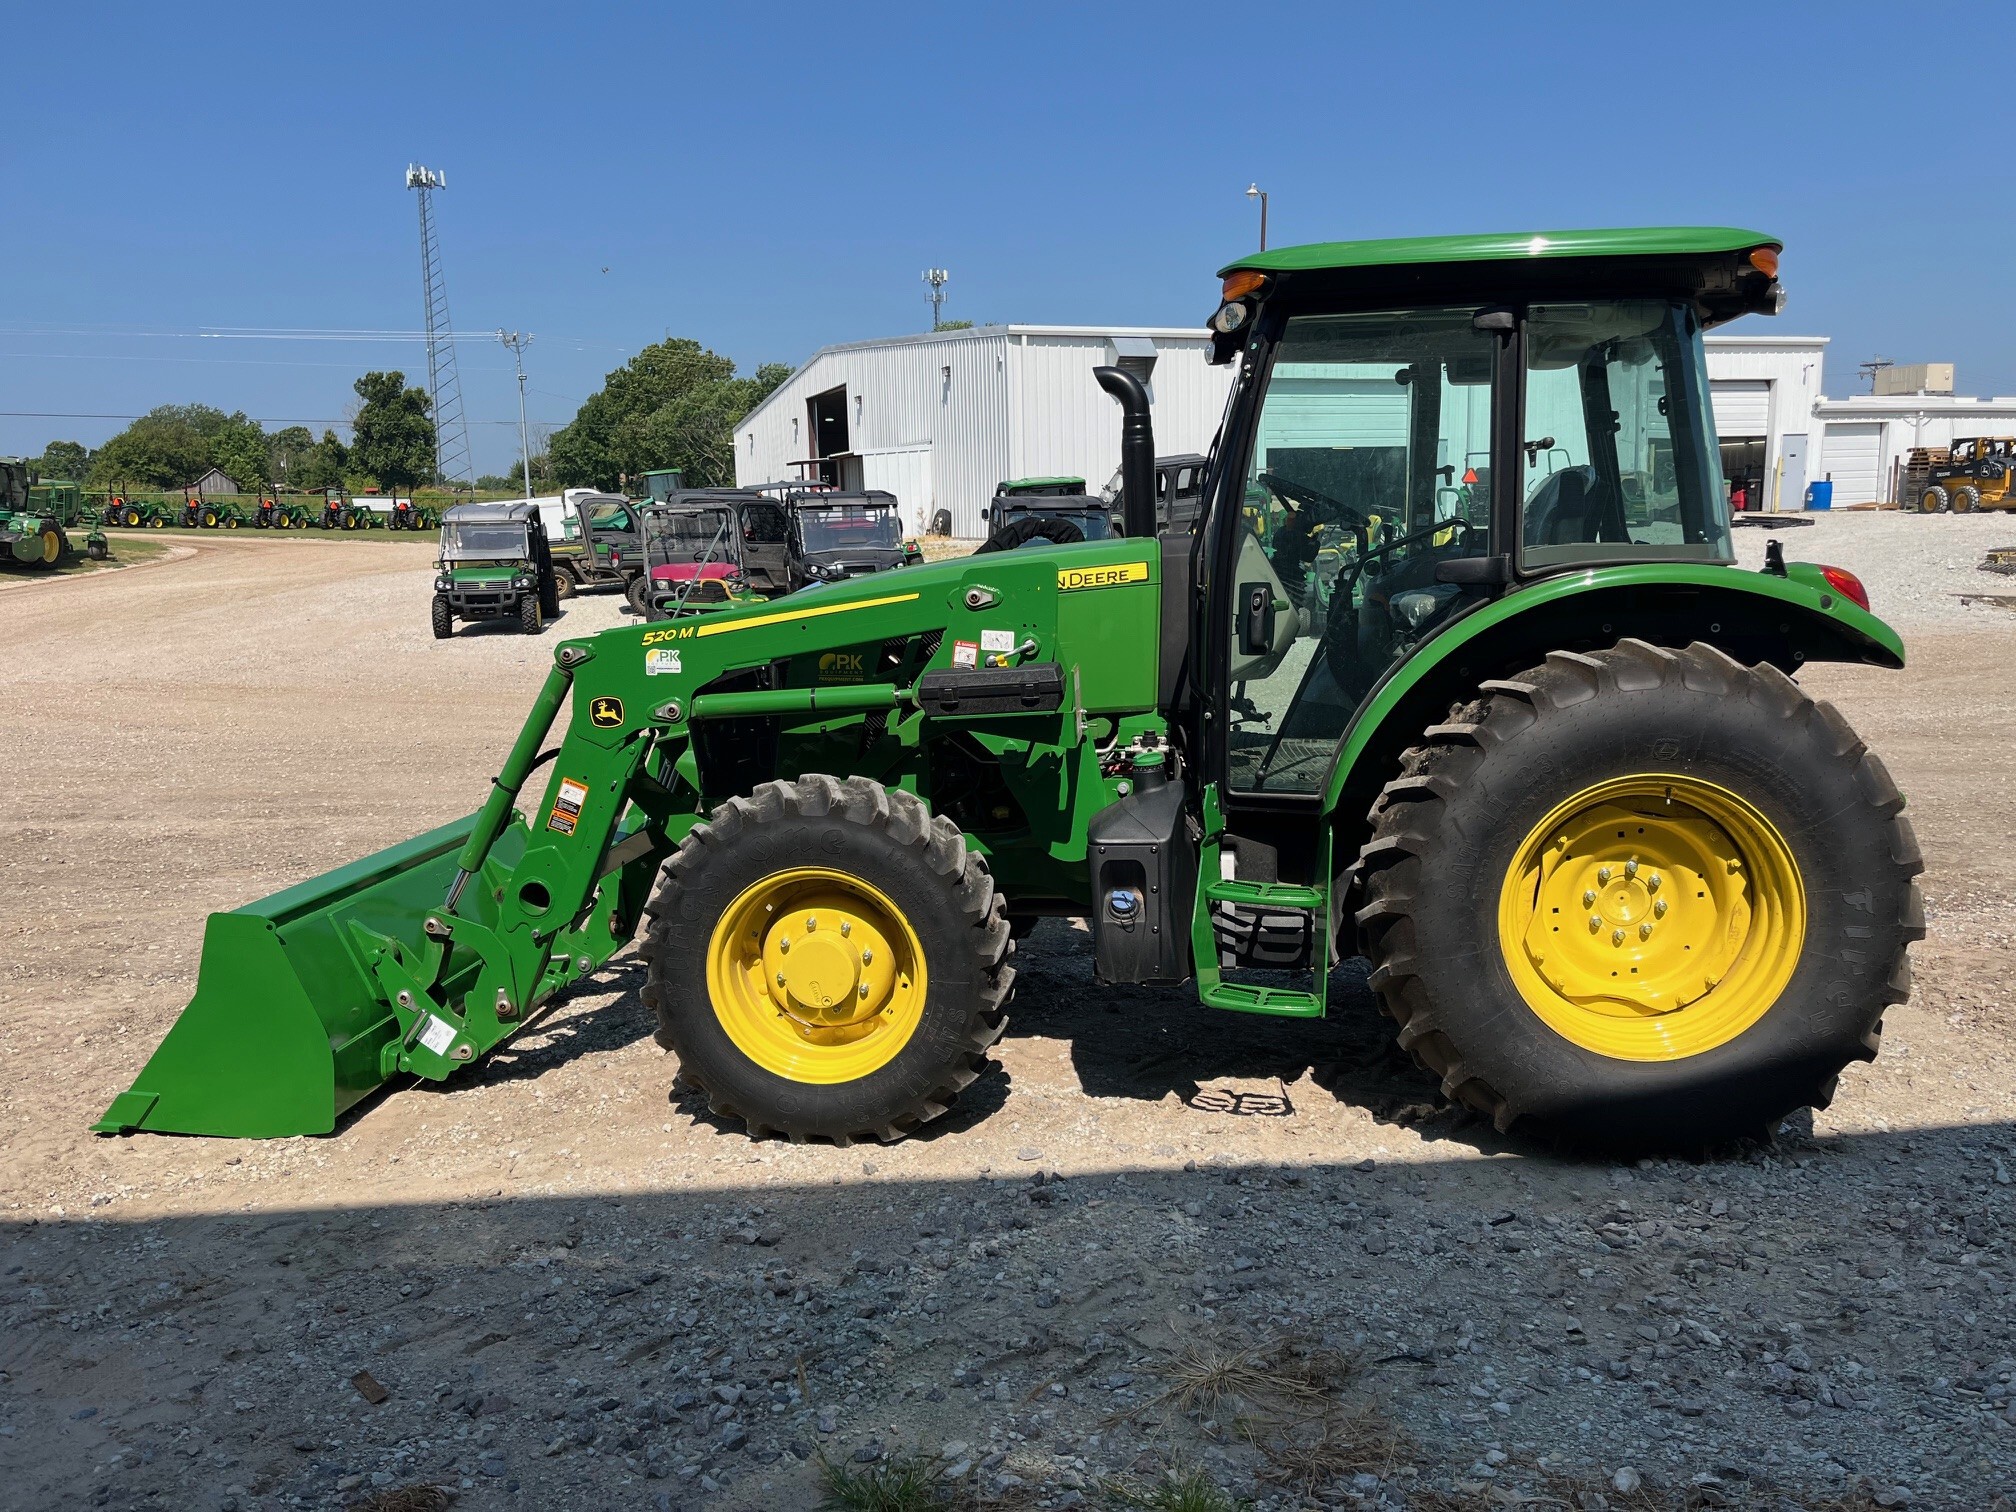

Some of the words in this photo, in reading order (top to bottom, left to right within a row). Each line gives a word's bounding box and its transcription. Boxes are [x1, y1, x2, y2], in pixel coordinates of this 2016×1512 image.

[1069, 569, 1129, 587] DEERE
[641, 629, 677, 646] 520
[678, 626, 694, 639] M
